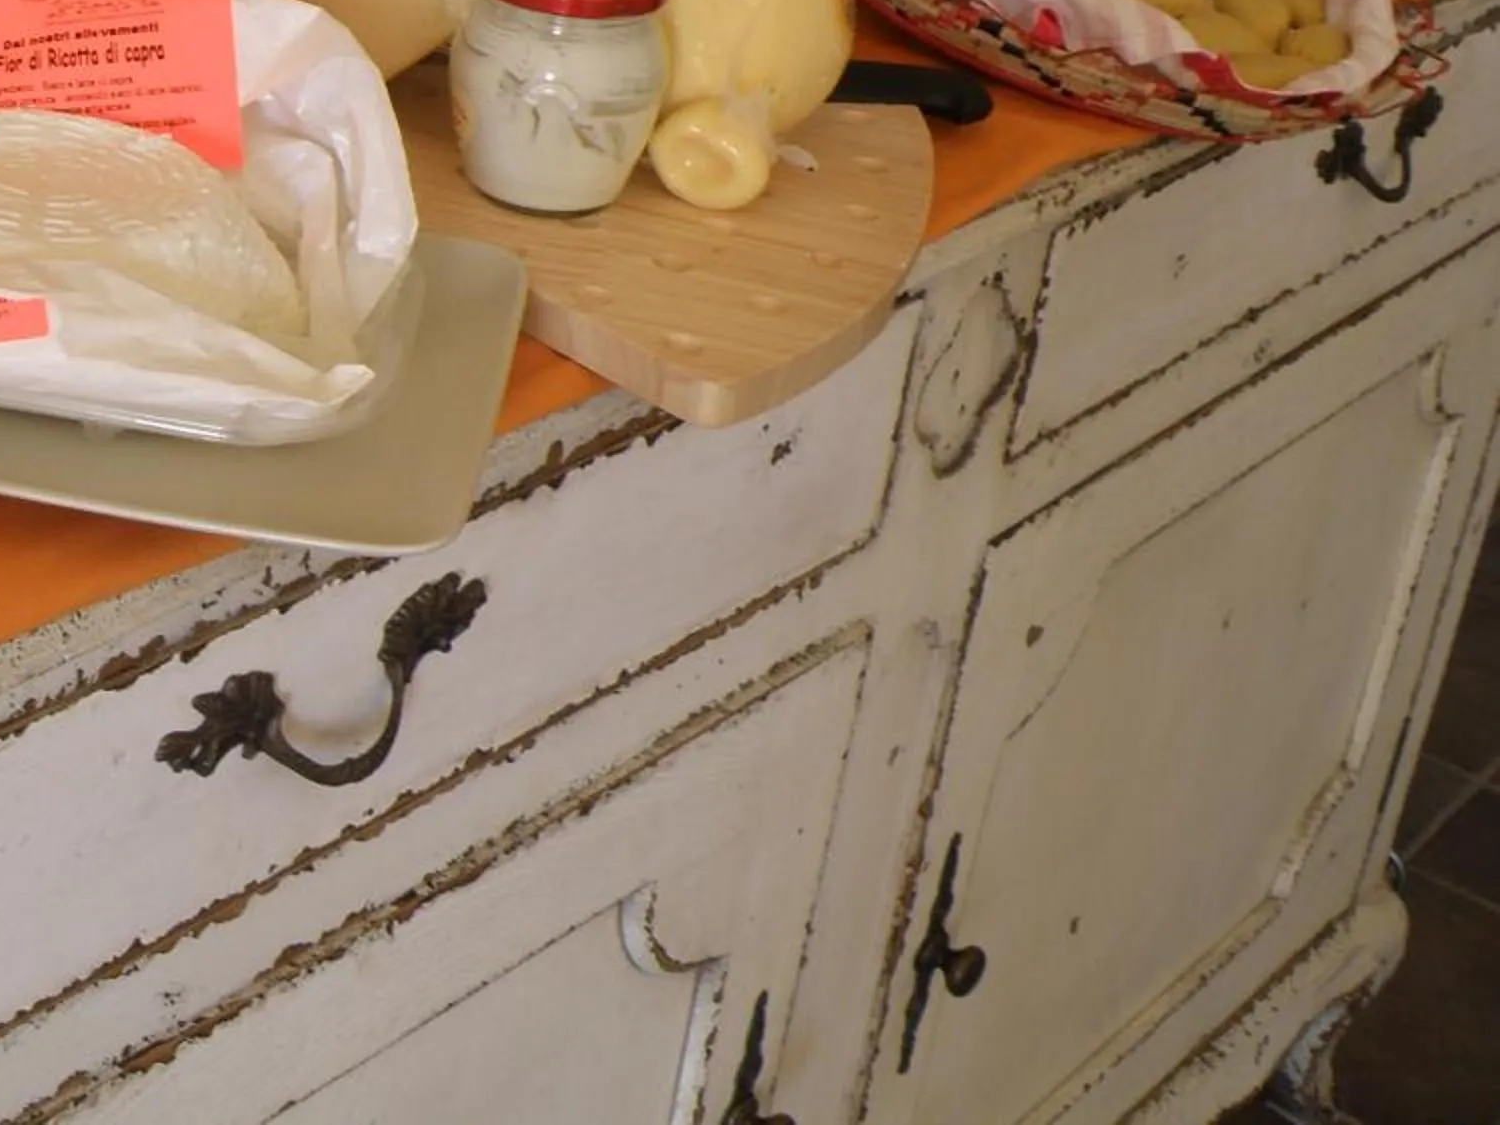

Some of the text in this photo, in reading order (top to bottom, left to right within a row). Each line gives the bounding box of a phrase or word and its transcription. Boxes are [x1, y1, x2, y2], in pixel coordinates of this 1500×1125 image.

[28, 51, 43, 71] di
[47, 44, 100, 70] Ricotta
[105, 43, 120, 65] di
[125, 42, 166, 69] capra
